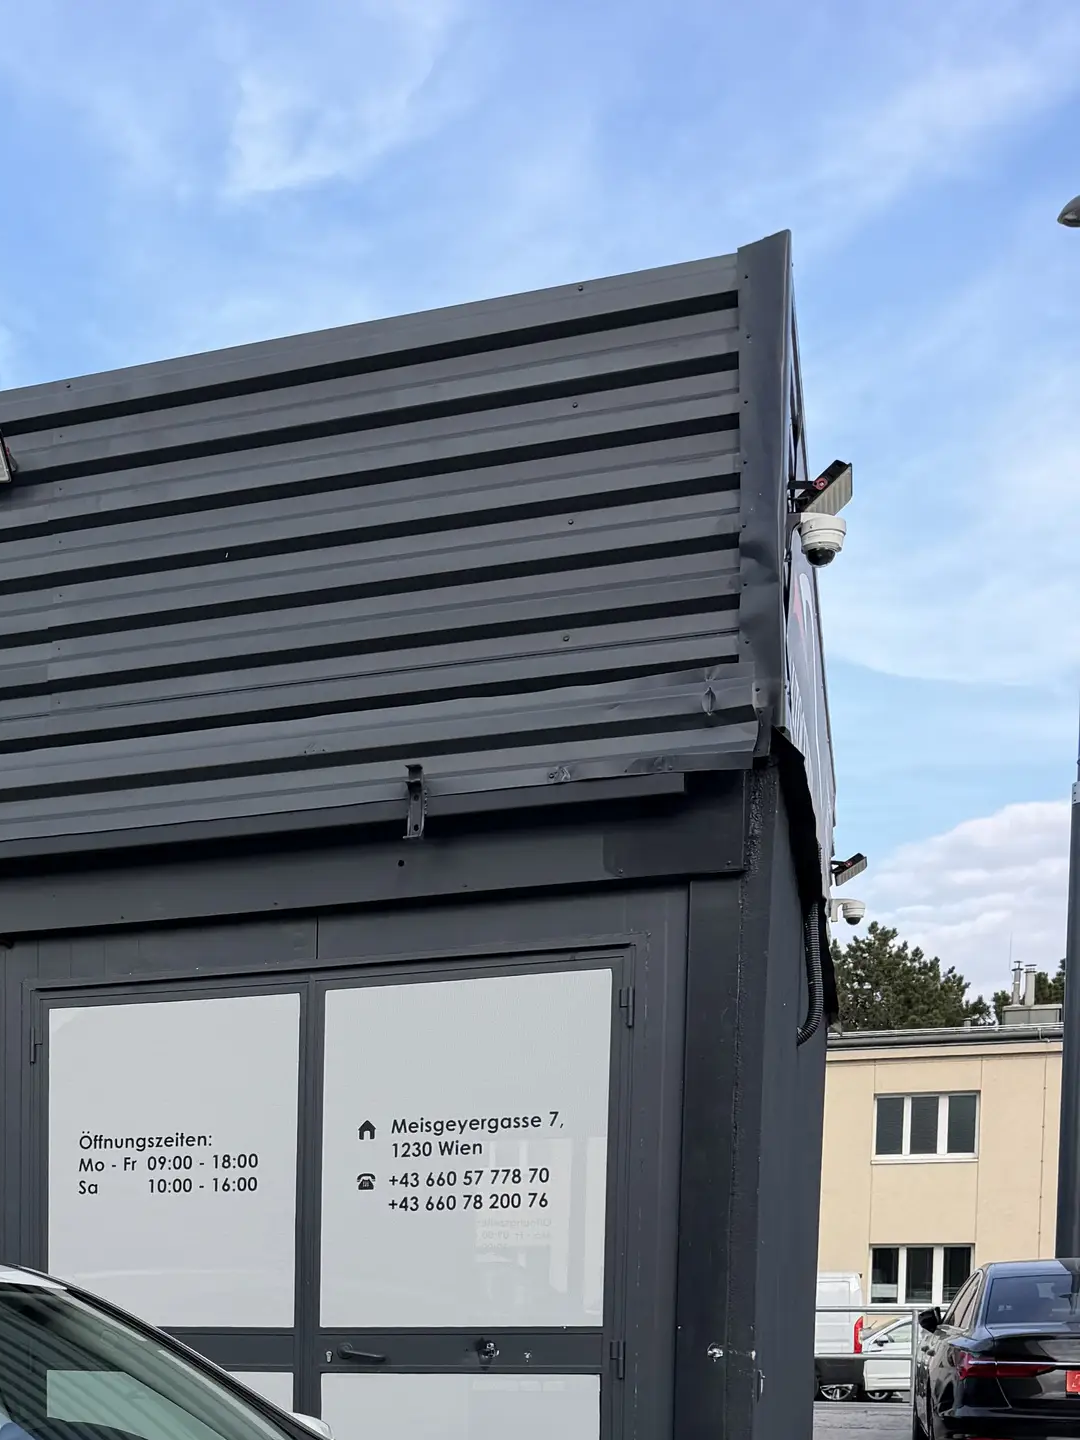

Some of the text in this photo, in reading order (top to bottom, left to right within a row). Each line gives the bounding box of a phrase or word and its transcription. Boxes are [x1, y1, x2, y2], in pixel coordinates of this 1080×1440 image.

[391, 1111, 564, 1137] Meisgeyergasse 7,
[79, 1130, 212, 1152] Öffnungszeiten:
[392, 1139, 483, 1158] 1230 Wien
[78, 1157, 105, 1172] Mo
[123, 1156, 138, 1172] Fr
[147, 1155, 193, 1171] 09:00
[212, 1153, 259, 1169] 18:00
[78, 1180, 98, 1195] Sa
[148, 1177, 193, 1194] 10:00
[212, 1176, 258, 1193] 16:00
[388, 1167, 550, 1188] +43 660 57 778 70
[388, 1192, 549, 1212] +43 660 78 200 76
